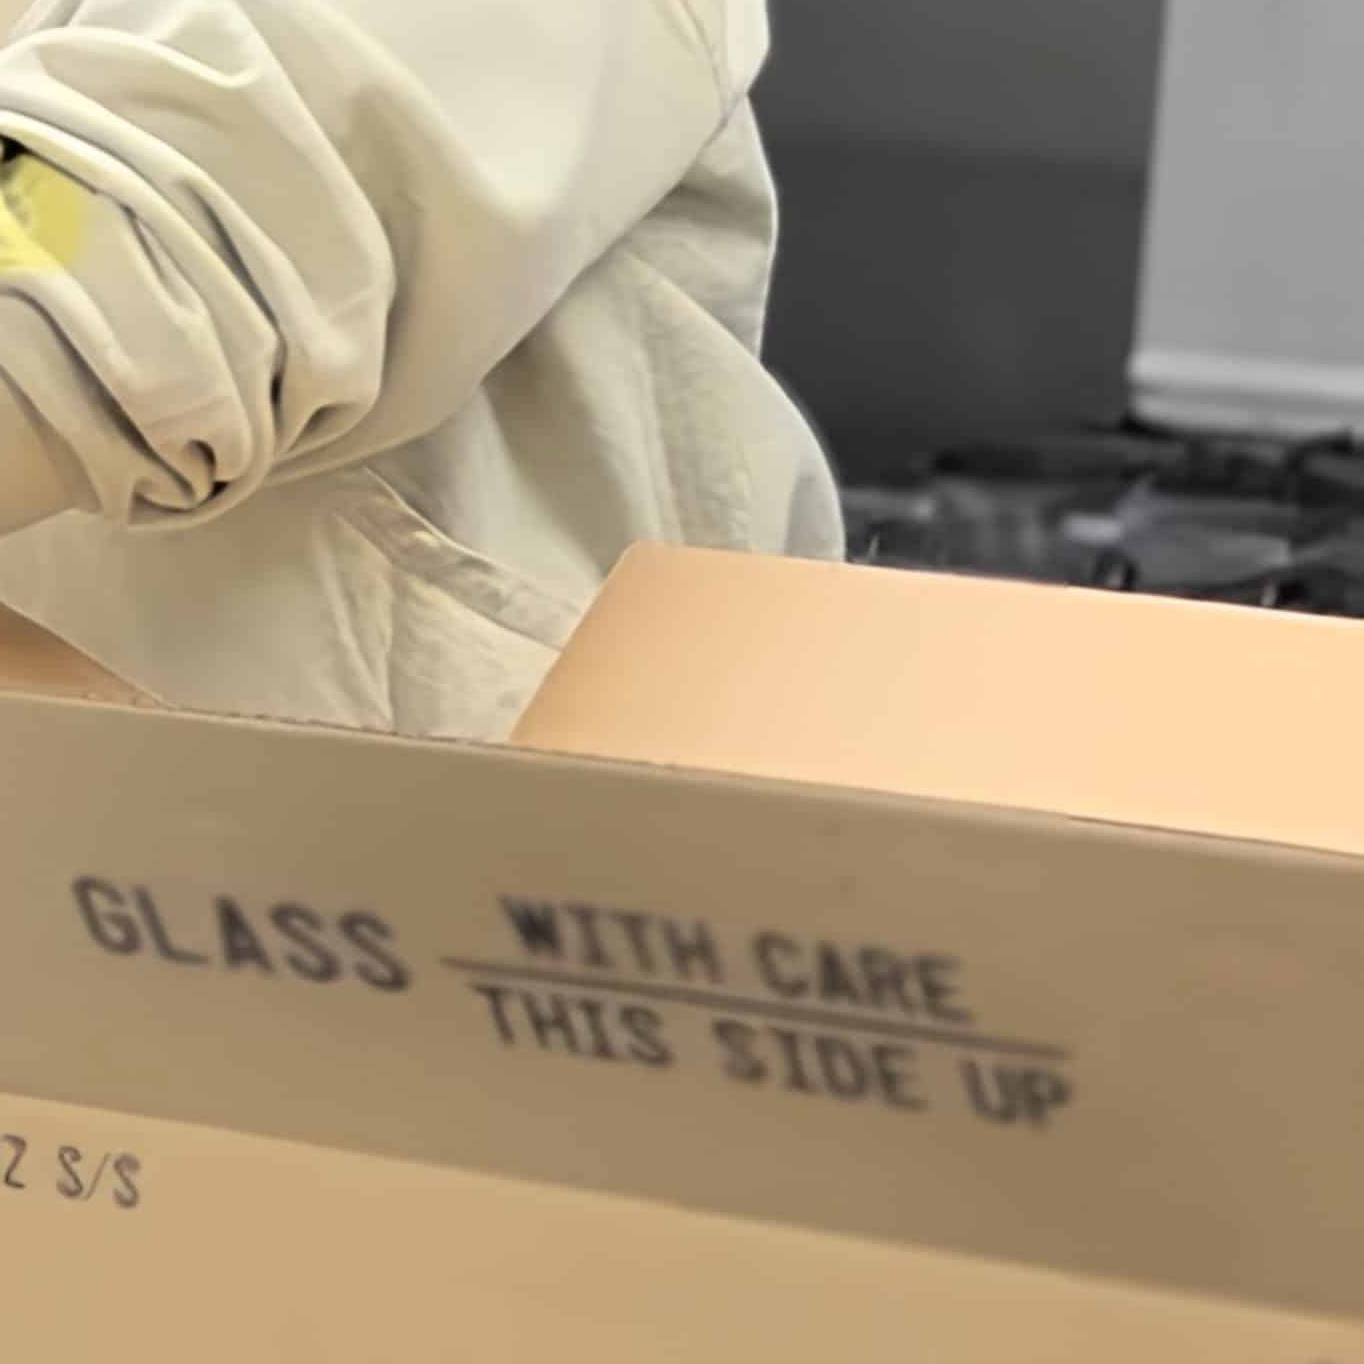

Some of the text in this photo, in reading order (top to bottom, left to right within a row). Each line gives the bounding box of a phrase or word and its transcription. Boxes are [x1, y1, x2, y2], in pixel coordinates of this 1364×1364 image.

[71, 874, 411, 993] GLASS
[497, 893, 975, 1026] WITH CARE
[470, 980, 1072, 1132] THIS SIDE UP
[55, 1143, 143, 1212] S/S
